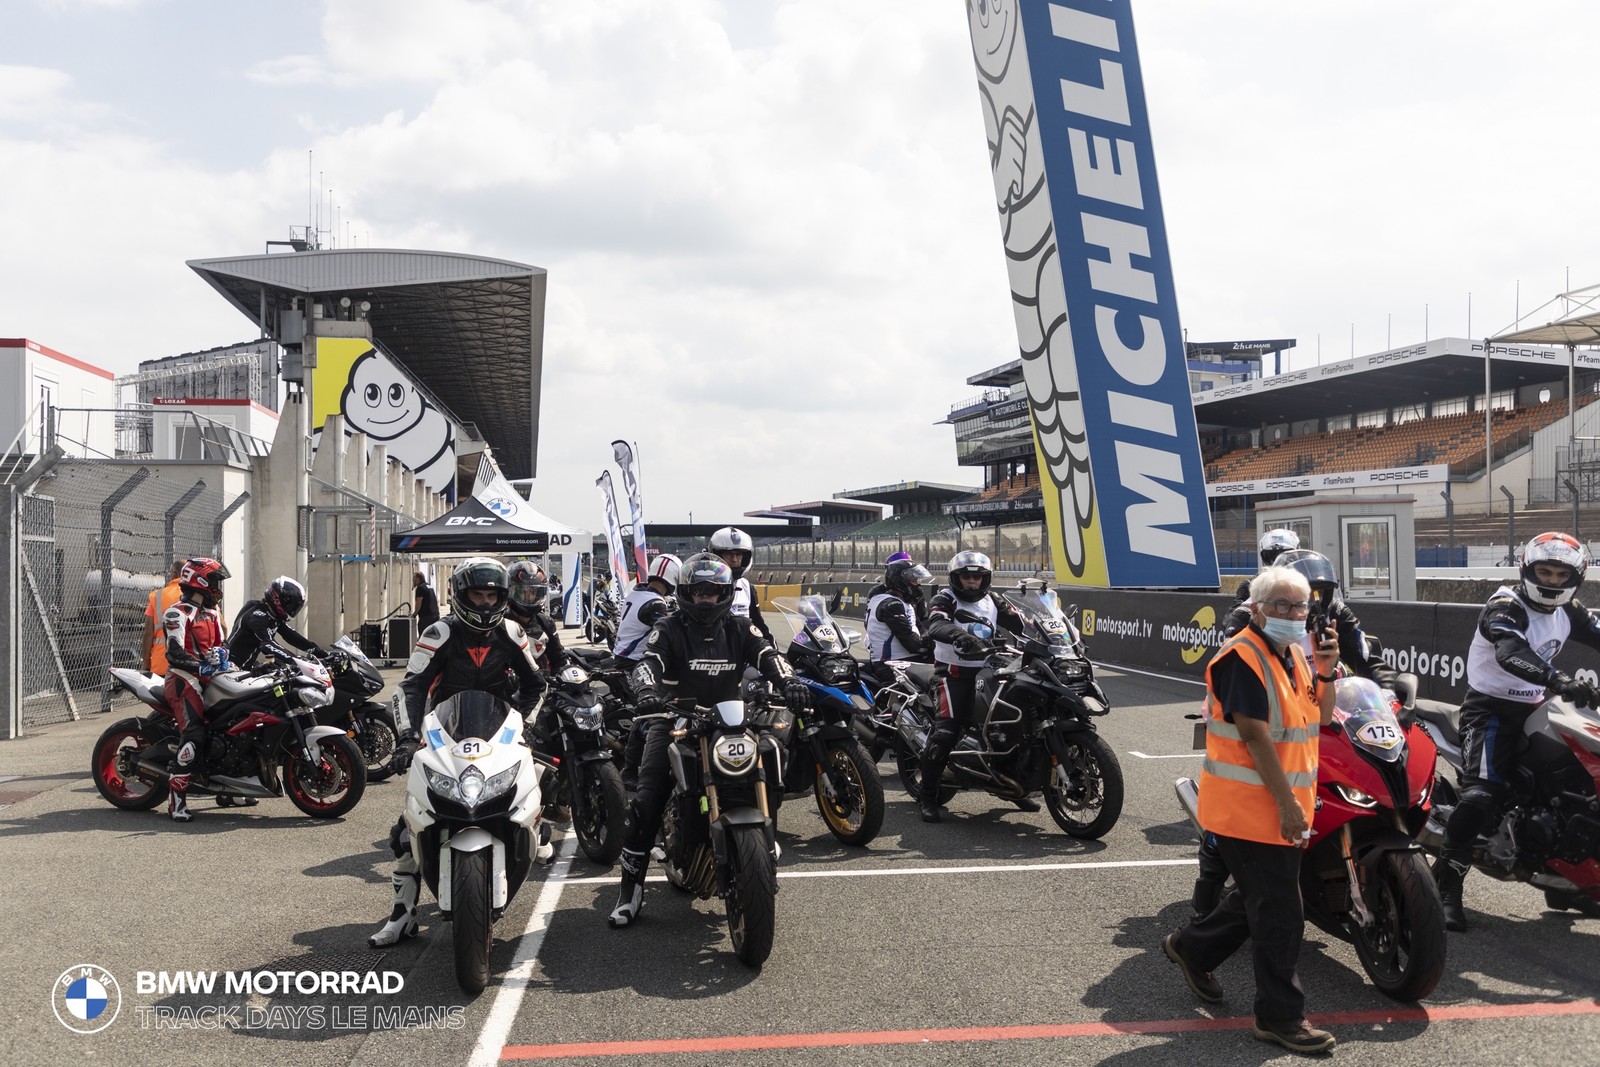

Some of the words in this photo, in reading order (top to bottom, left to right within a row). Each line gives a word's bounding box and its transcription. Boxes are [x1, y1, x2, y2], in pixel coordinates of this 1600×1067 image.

[1048, 0, 1197, 566] MICHELI
[1368, 346, 1427, 366] PORSCHE
[1471, 344, 1556, 360] PORSCHE
[1320, 363, 1354, 376] #TeamPorsche
[1263, 372, 1308, 387] PORSCHE
[1213, 384, 1253, 398] PORSCHE
[995, 403, 1021, 416] AUTOMOBILE
[1323, 476, 1355, 486] #TeamPorsche
[1370, 470, 1429, 481] PORSCHE
[1216, 484, 1255, 493] PORSCHE
[1266, 480, 1310, 490] PORSCHE
[445, 516, 497, 526] BMC
[1096, 617, 1153, 639] motorsport.tv
[1162, 622, 1226, 650] motorsport.c
[1505, 656, 1544, 674] RST
[1508, 688, 1534, 697] BMW
[1367, 725, 1396, 740] 175
[463, 742, 480, 754] 61
[728, 743, 745, 757] 20
